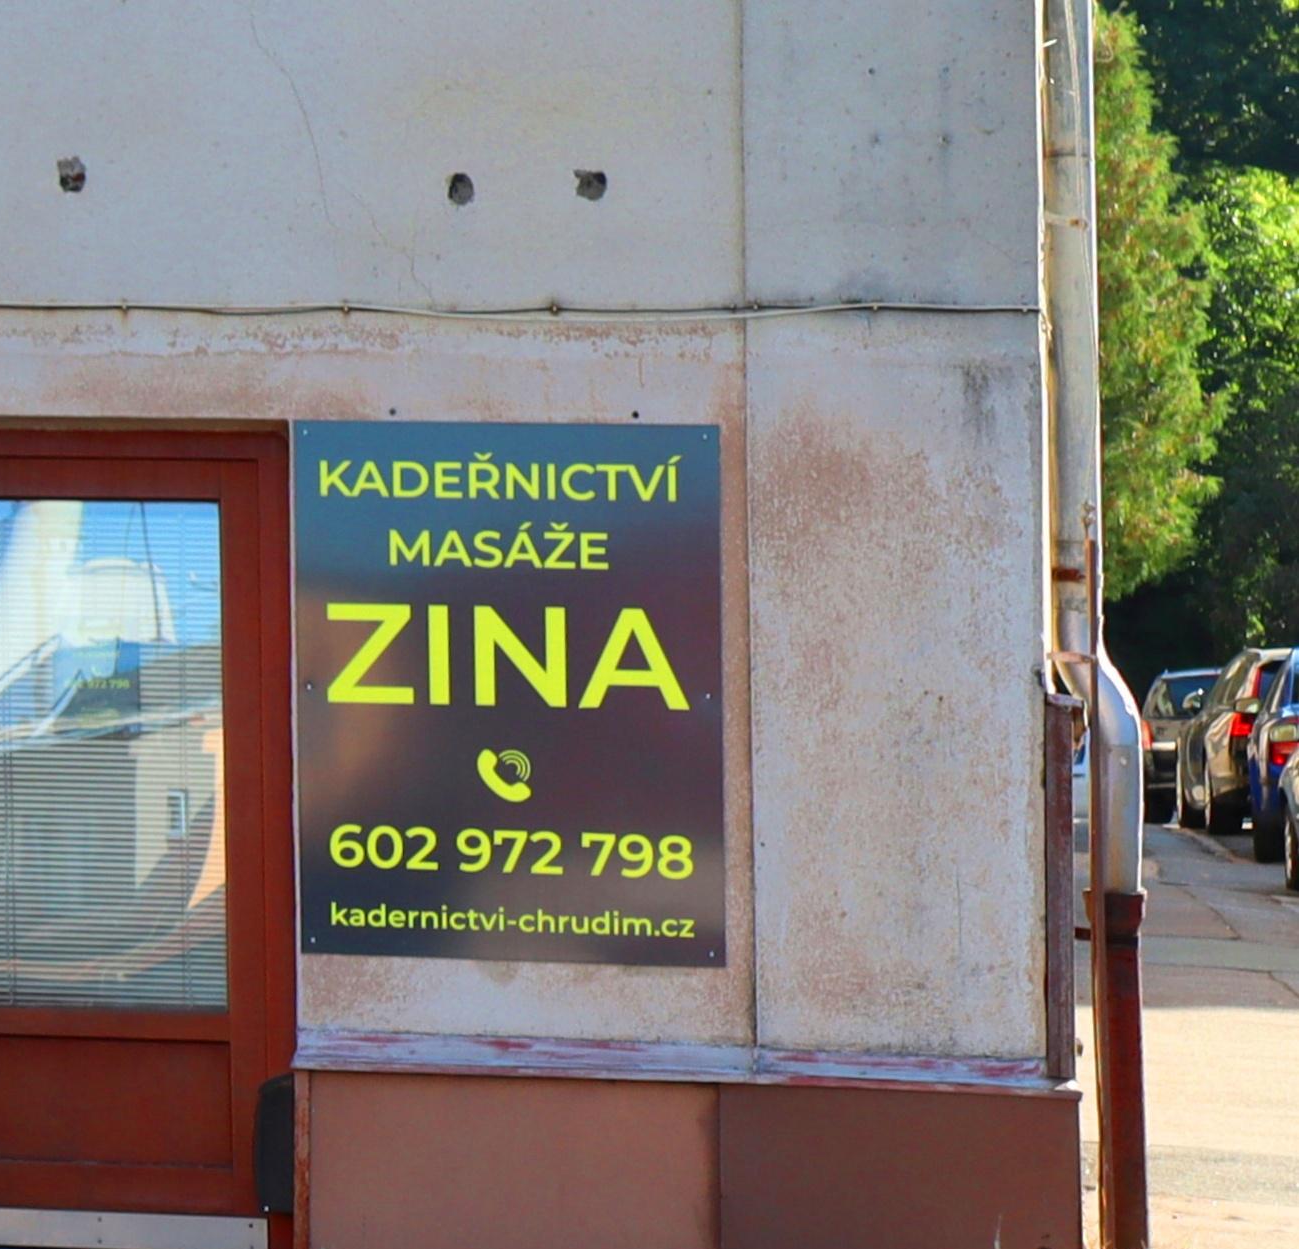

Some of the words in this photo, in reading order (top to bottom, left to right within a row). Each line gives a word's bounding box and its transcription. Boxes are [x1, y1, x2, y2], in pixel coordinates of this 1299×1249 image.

[319, 453, 682, 502] KADEŘNICTVÍ
[389, 522, 610, 570] MASÁŽE
[326, 603, 690, 710] ZINA
[329, 825, 439, 871] 602
[456, 829, 564, 876] 972
[581, 833, 695, 880] 798
[330, 902, 695, 939] kadernictvi-chrudim.cz
